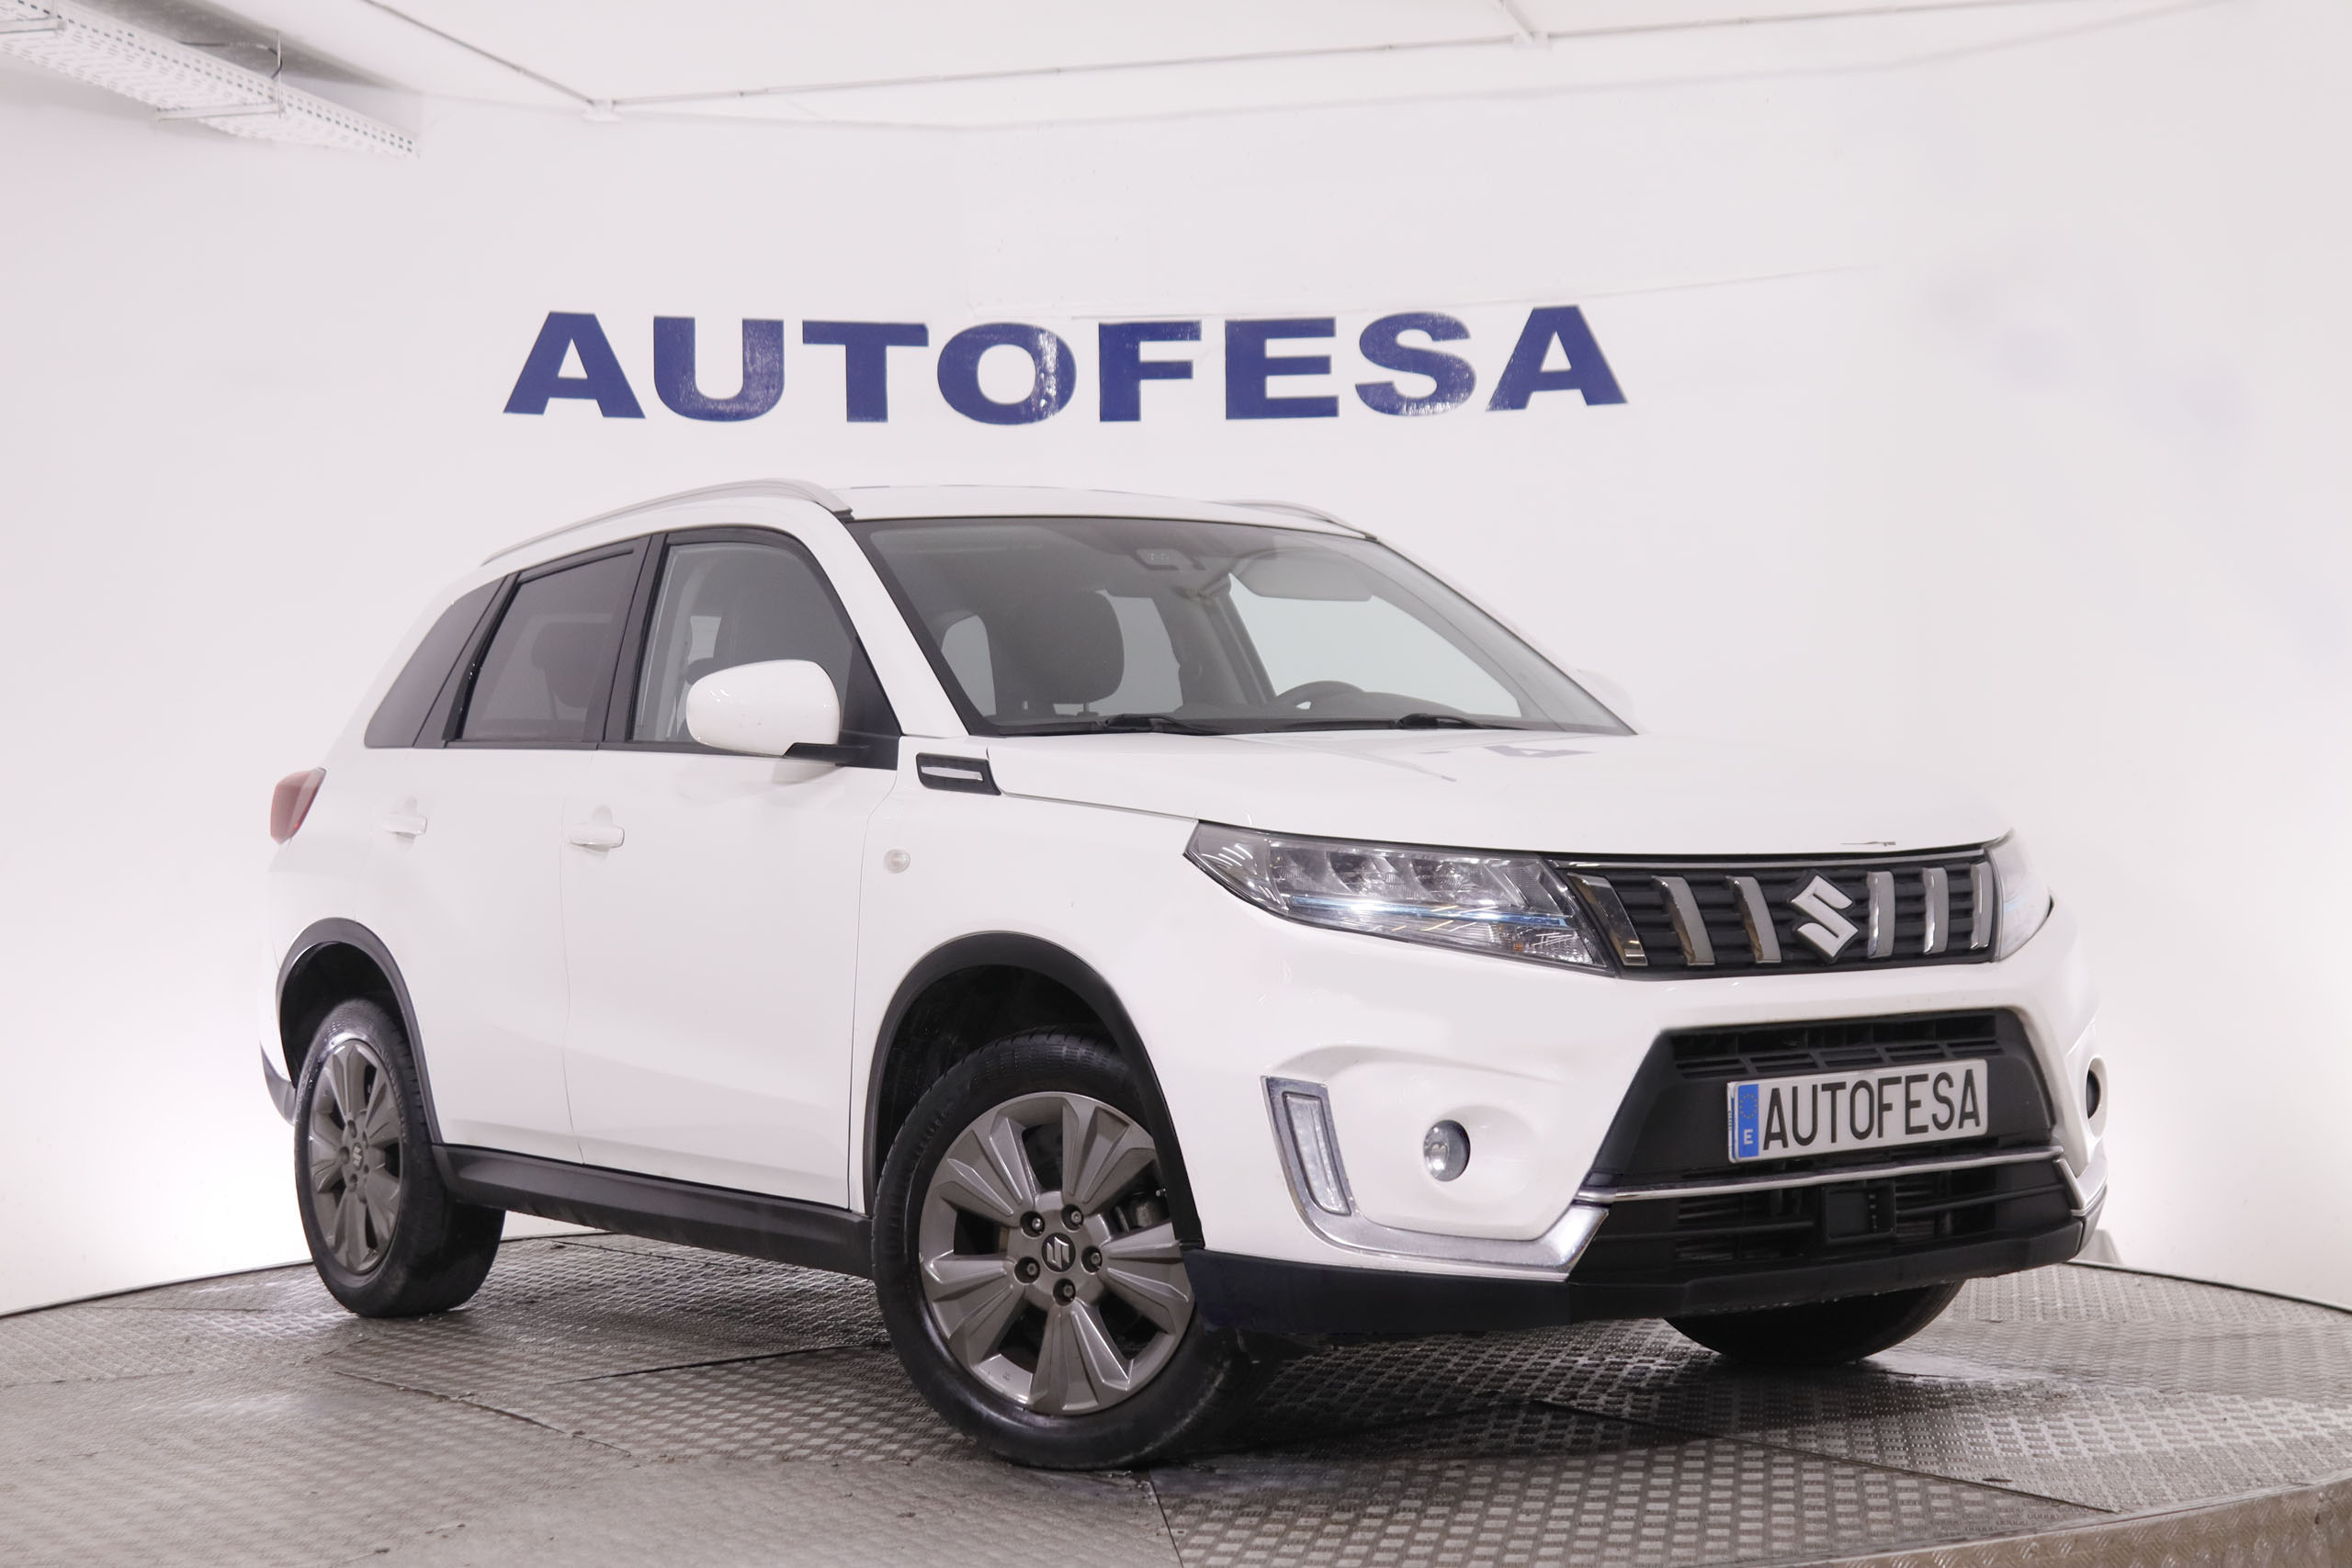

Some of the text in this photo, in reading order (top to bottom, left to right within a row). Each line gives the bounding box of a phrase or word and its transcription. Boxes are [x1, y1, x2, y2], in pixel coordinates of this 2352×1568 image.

[503, 305, 1627, 425] AUTOFESA
[1744, 1129, 1754, 1145] E
[1763, 1068, 1981, 1150] AUTOFESA
